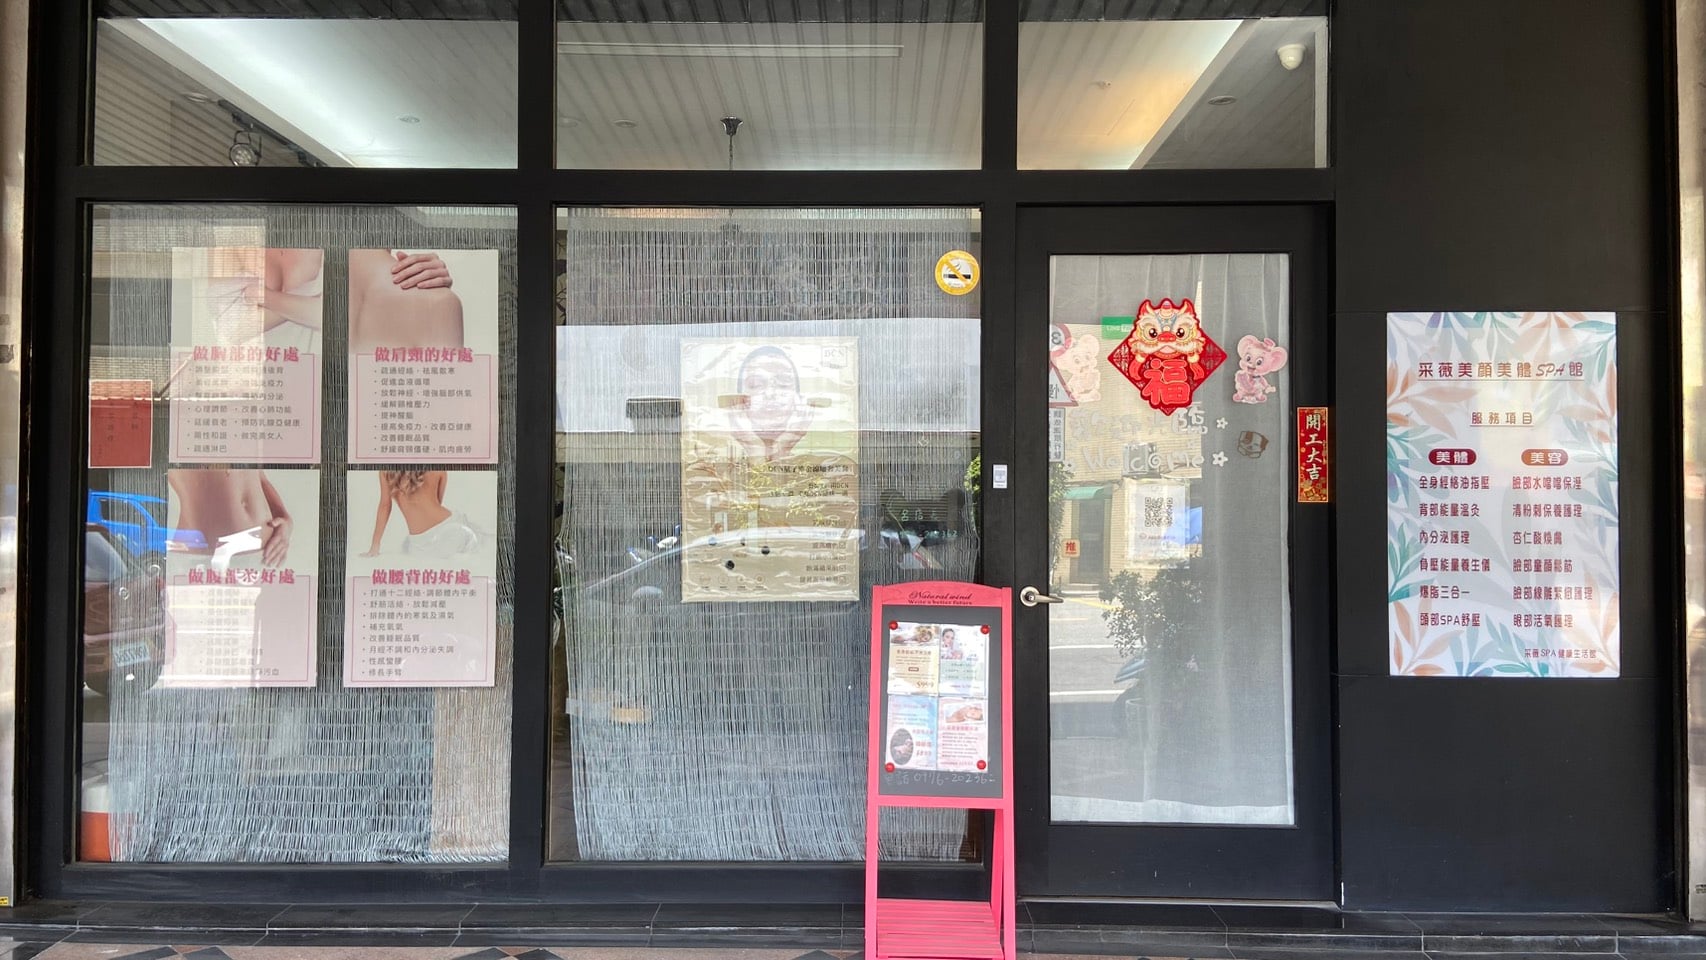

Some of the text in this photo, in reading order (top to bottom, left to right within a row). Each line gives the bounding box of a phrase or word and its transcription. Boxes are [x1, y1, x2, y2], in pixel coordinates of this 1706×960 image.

[193, 346, 299, 362] 做胸部的好處
[375, 347, 473, 363] 做肩頸的好處
[1143, 358, 1191, 404] 福
[1471, 411, 1533, 425] 服務項目
[1305, 413, 1323, 480] 開工大吉
[1436, 451, 1469, 464] 美體
[1530, 451, 1562, 464] 美容
[1419, 475, 1490, 490] 全身經絡油指壓
[1419, 503, 1480, 517] 背部能量溫灸
[1512, 504, 1582, 518] 清粉刺保養護理
[372, 569, 471, 585] 做腰背的好處
[908, 591, 949, 599] Natural
[1420, 612, 1481, 627] 頭部SPA舒壓
